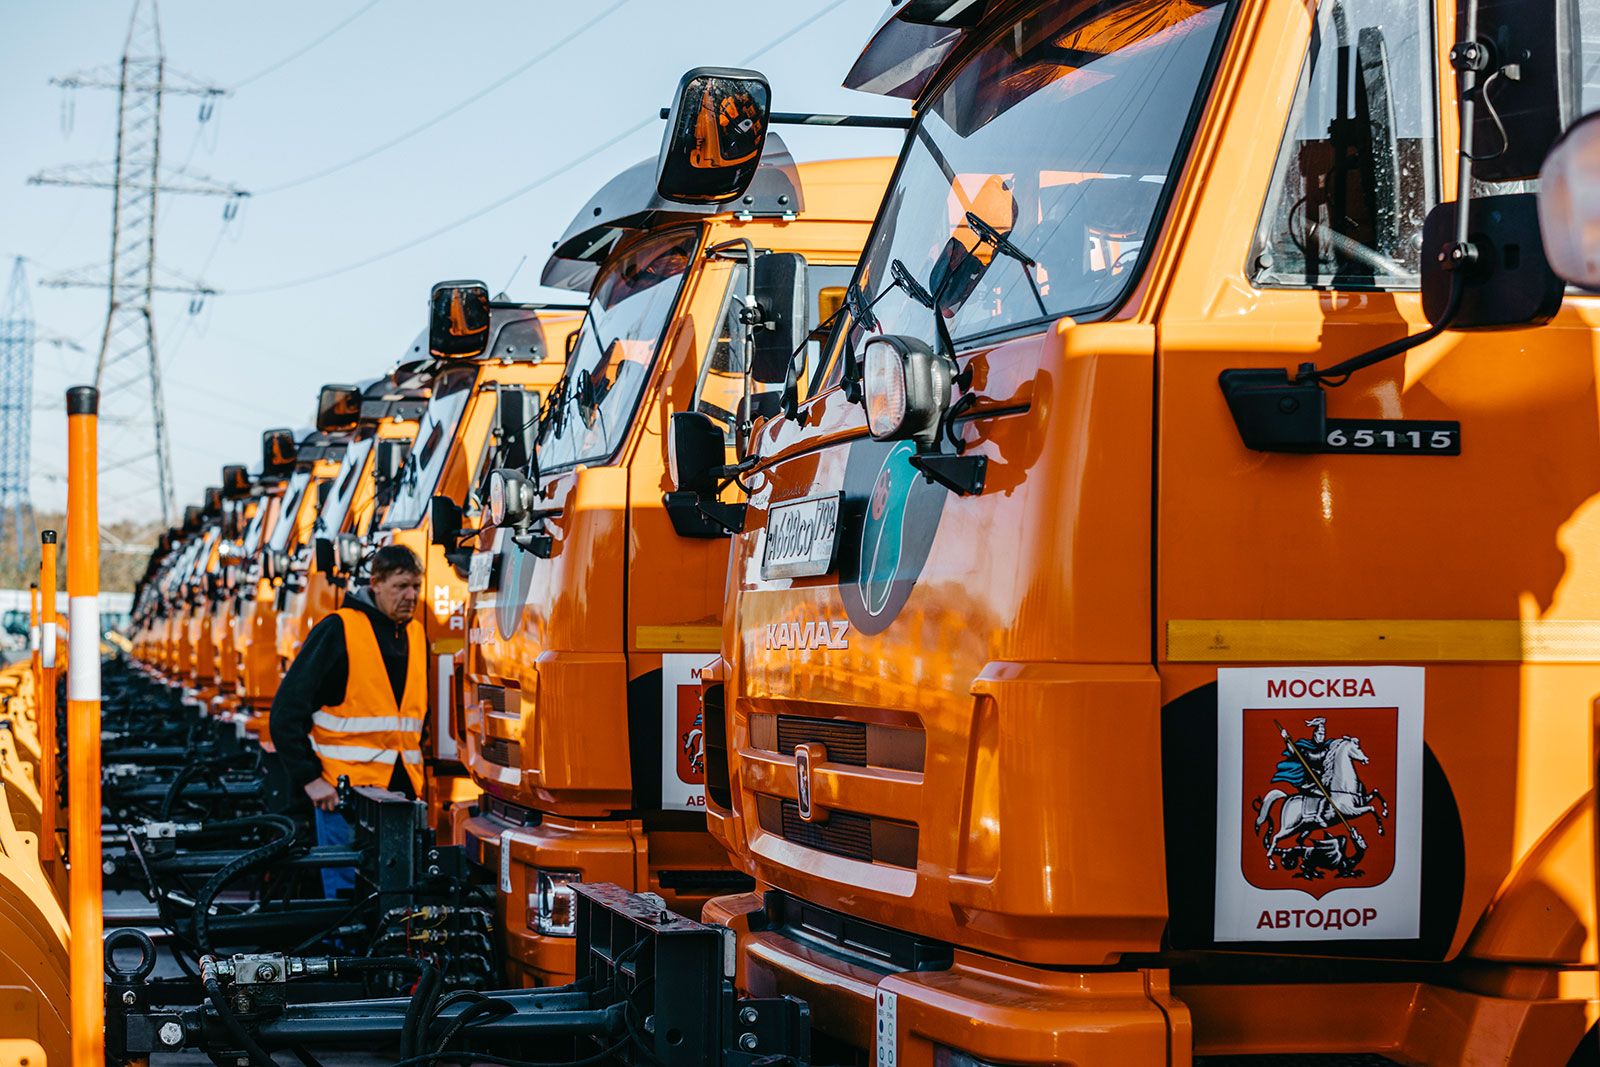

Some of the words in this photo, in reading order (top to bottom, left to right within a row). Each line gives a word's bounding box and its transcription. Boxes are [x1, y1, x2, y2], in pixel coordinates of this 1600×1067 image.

[1326, 429, 1451, 449] 65115
[766, 621, 849, 650] KAMAZ
[1267, 678, 1376, 699] МОСКВА
[1256, 907, 1378, 931] АВТОДОР
